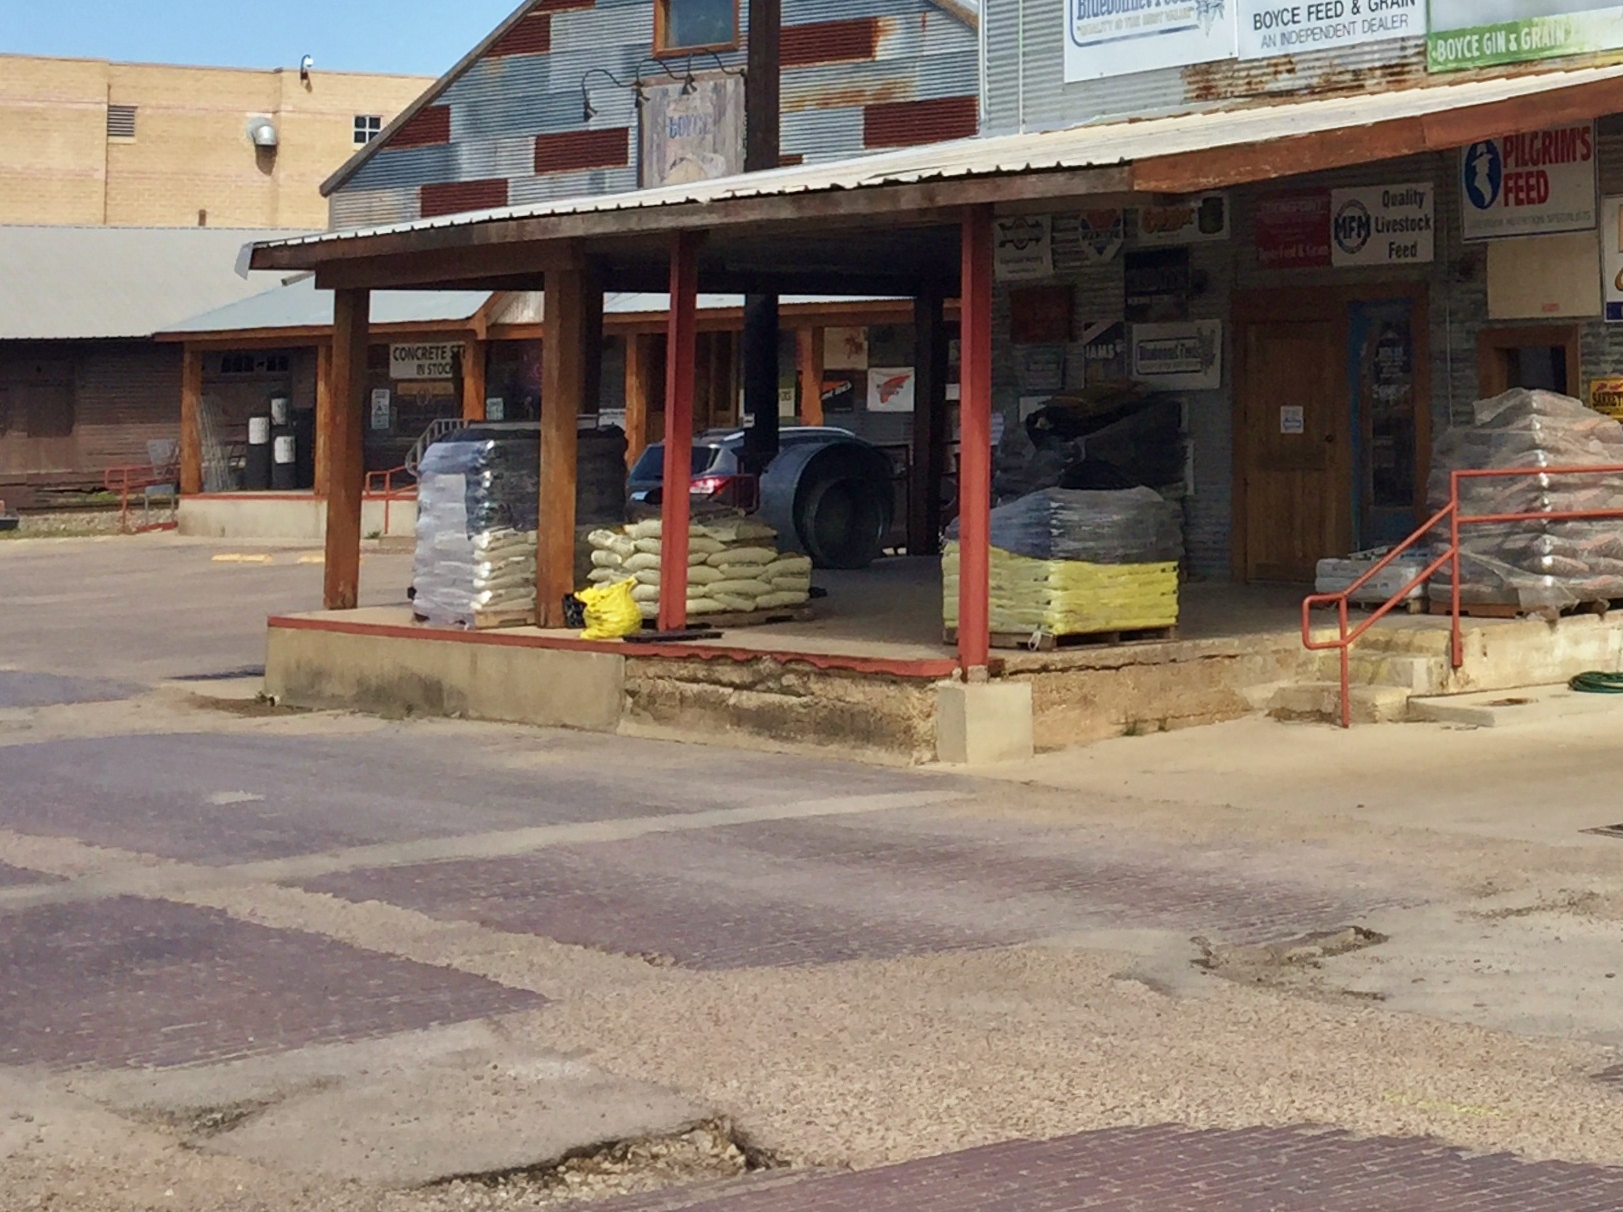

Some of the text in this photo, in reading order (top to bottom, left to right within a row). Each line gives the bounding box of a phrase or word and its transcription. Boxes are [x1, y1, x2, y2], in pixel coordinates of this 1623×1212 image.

[1253, 7, 1301, 31] BOYCE
[1307, 0, 1345, 23] FEED
[1261, 13, 1409, 50] AN INDEPENDENT DEALER
[1436, 19, 1566, 62] BOYCE GIN & GRAIN
[1502, 125, 1592, 169] PILGRIM'S
[1382, 189, 1426, 209] Quality
[1504, 170, 1550, 207] FEED
[1334, 215, 1372, 240] MFM
[1375, 214, 1432, 233] Livestock
[1388, 241, 1418, 259] Feed
[392, 345, 448, 362] CONCRETE
